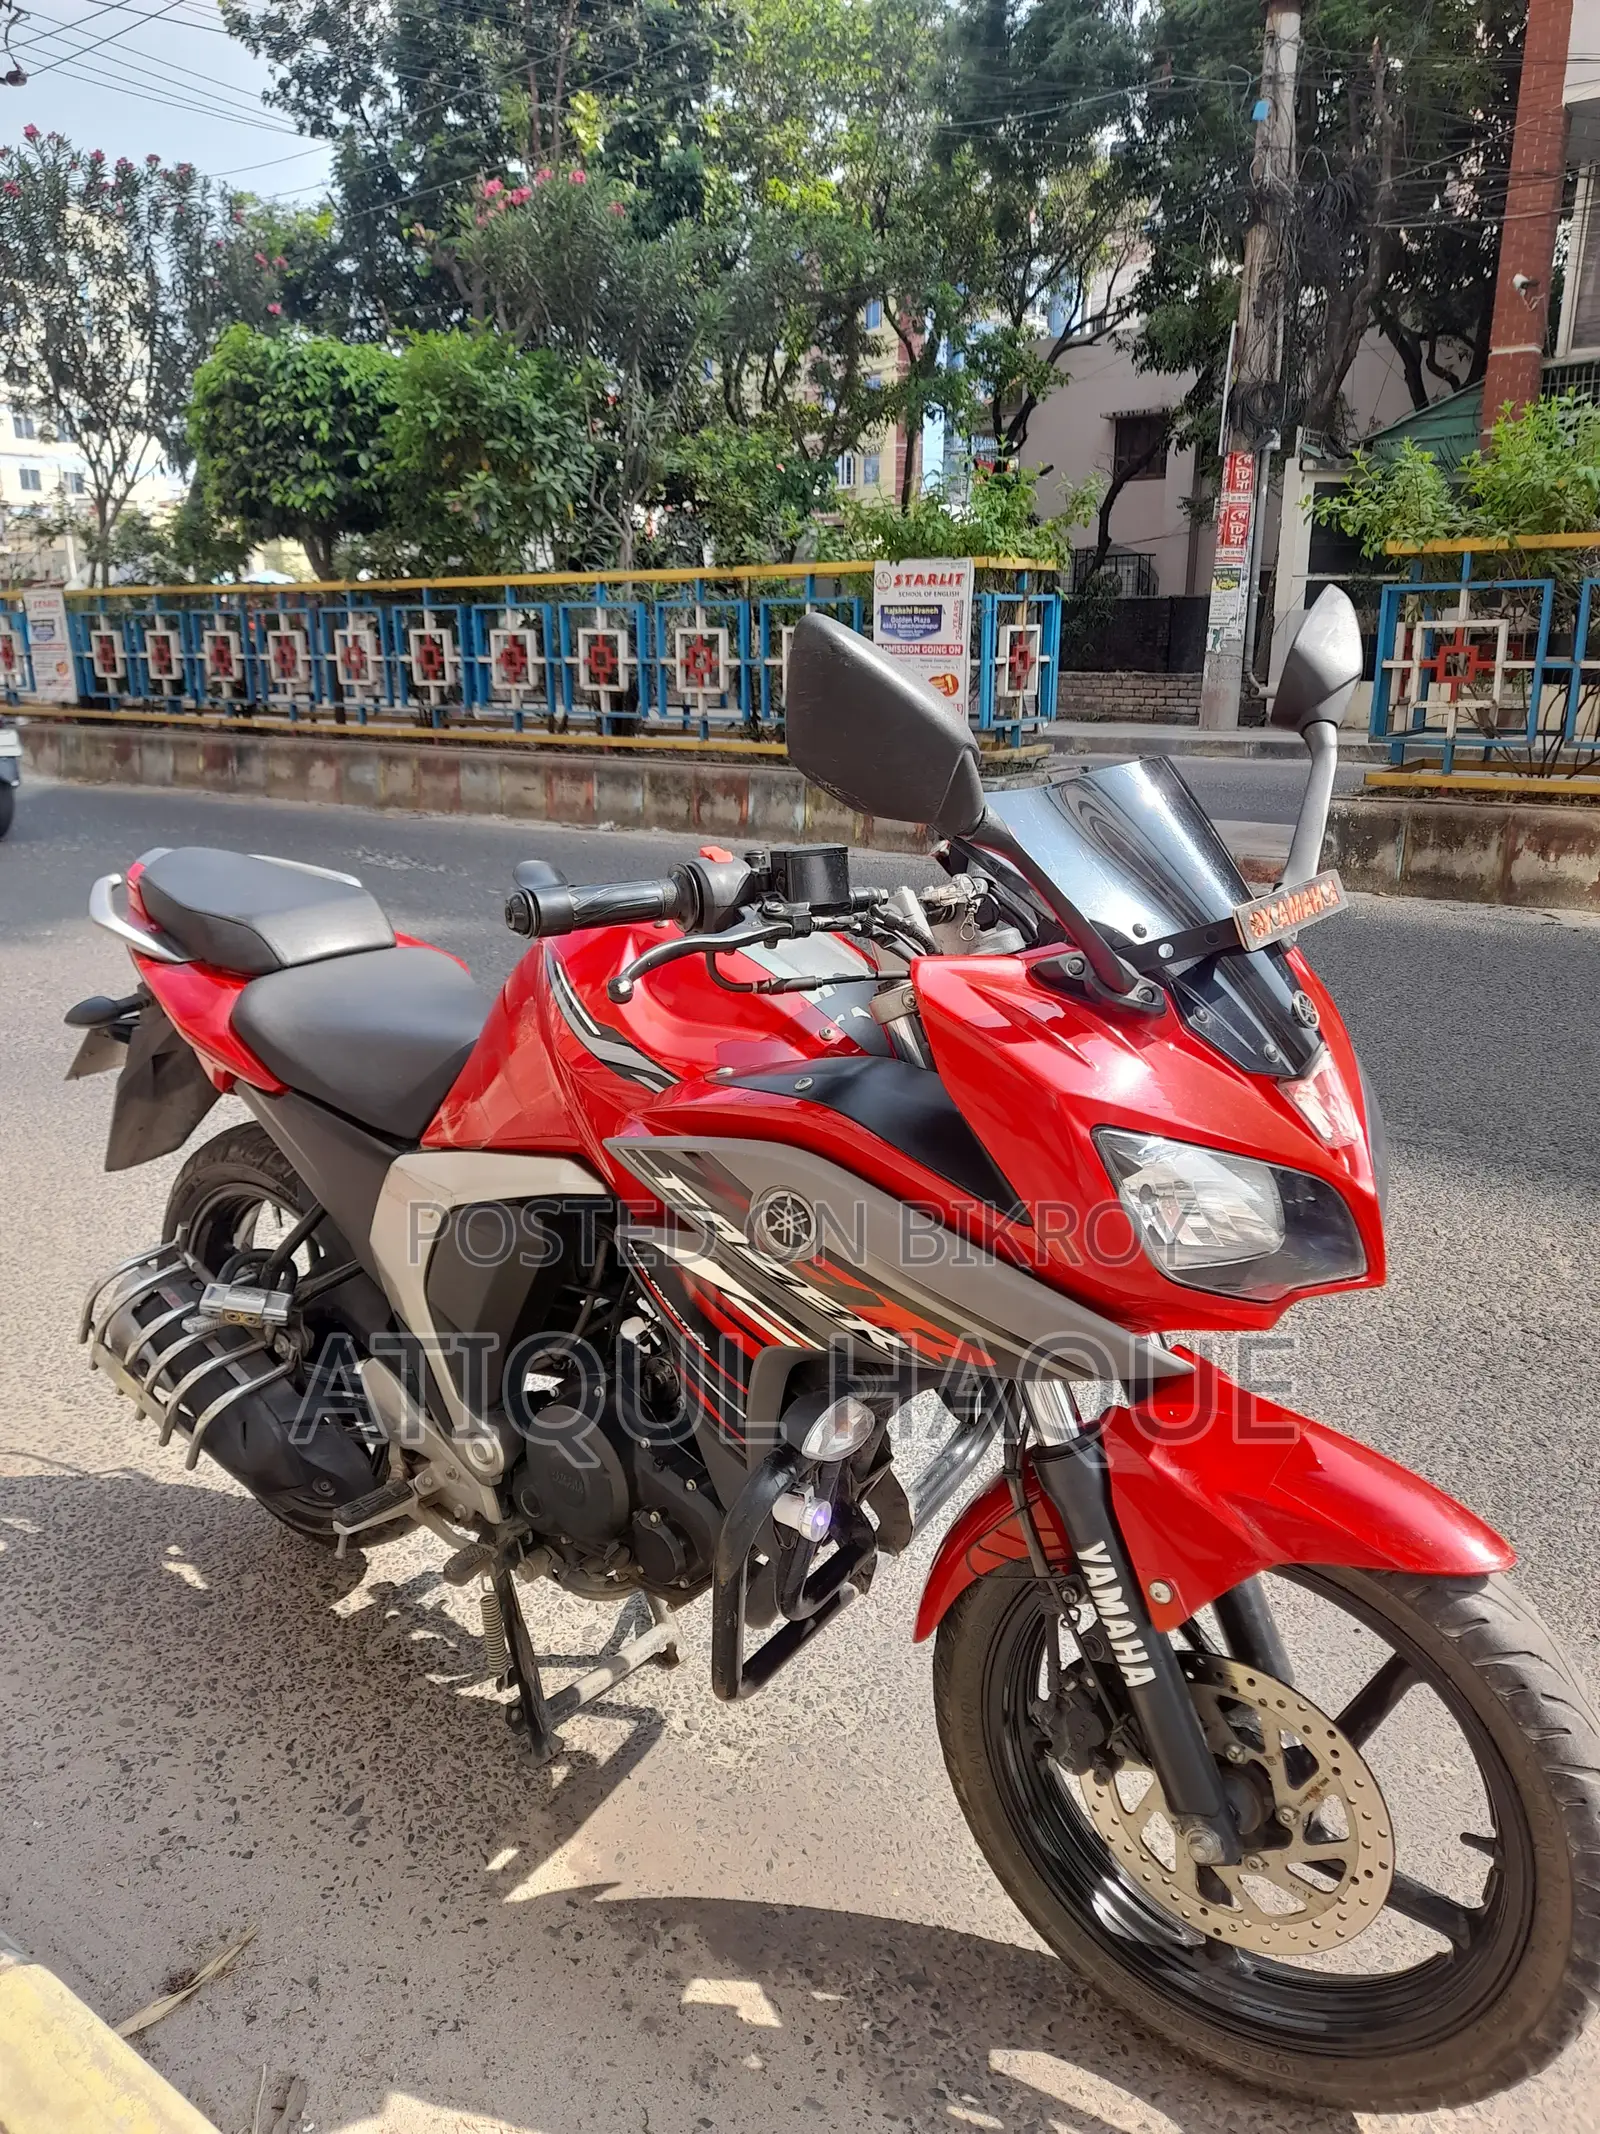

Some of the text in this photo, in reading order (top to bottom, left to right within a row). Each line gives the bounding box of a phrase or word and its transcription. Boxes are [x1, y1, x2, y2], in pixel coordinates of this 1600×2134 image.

[894, 573, 965, 588] STARLIT
[923, 590, 932, 598] OF
[934, 590, 960, 598] ENGLISH
[884, 606, 939, 615] Rajshahi Branch
[921, 645, 947, 654] GOING
[948, 645, 961, 654] ON
[1076, 1540, 1158, 1688] YAMAHA
